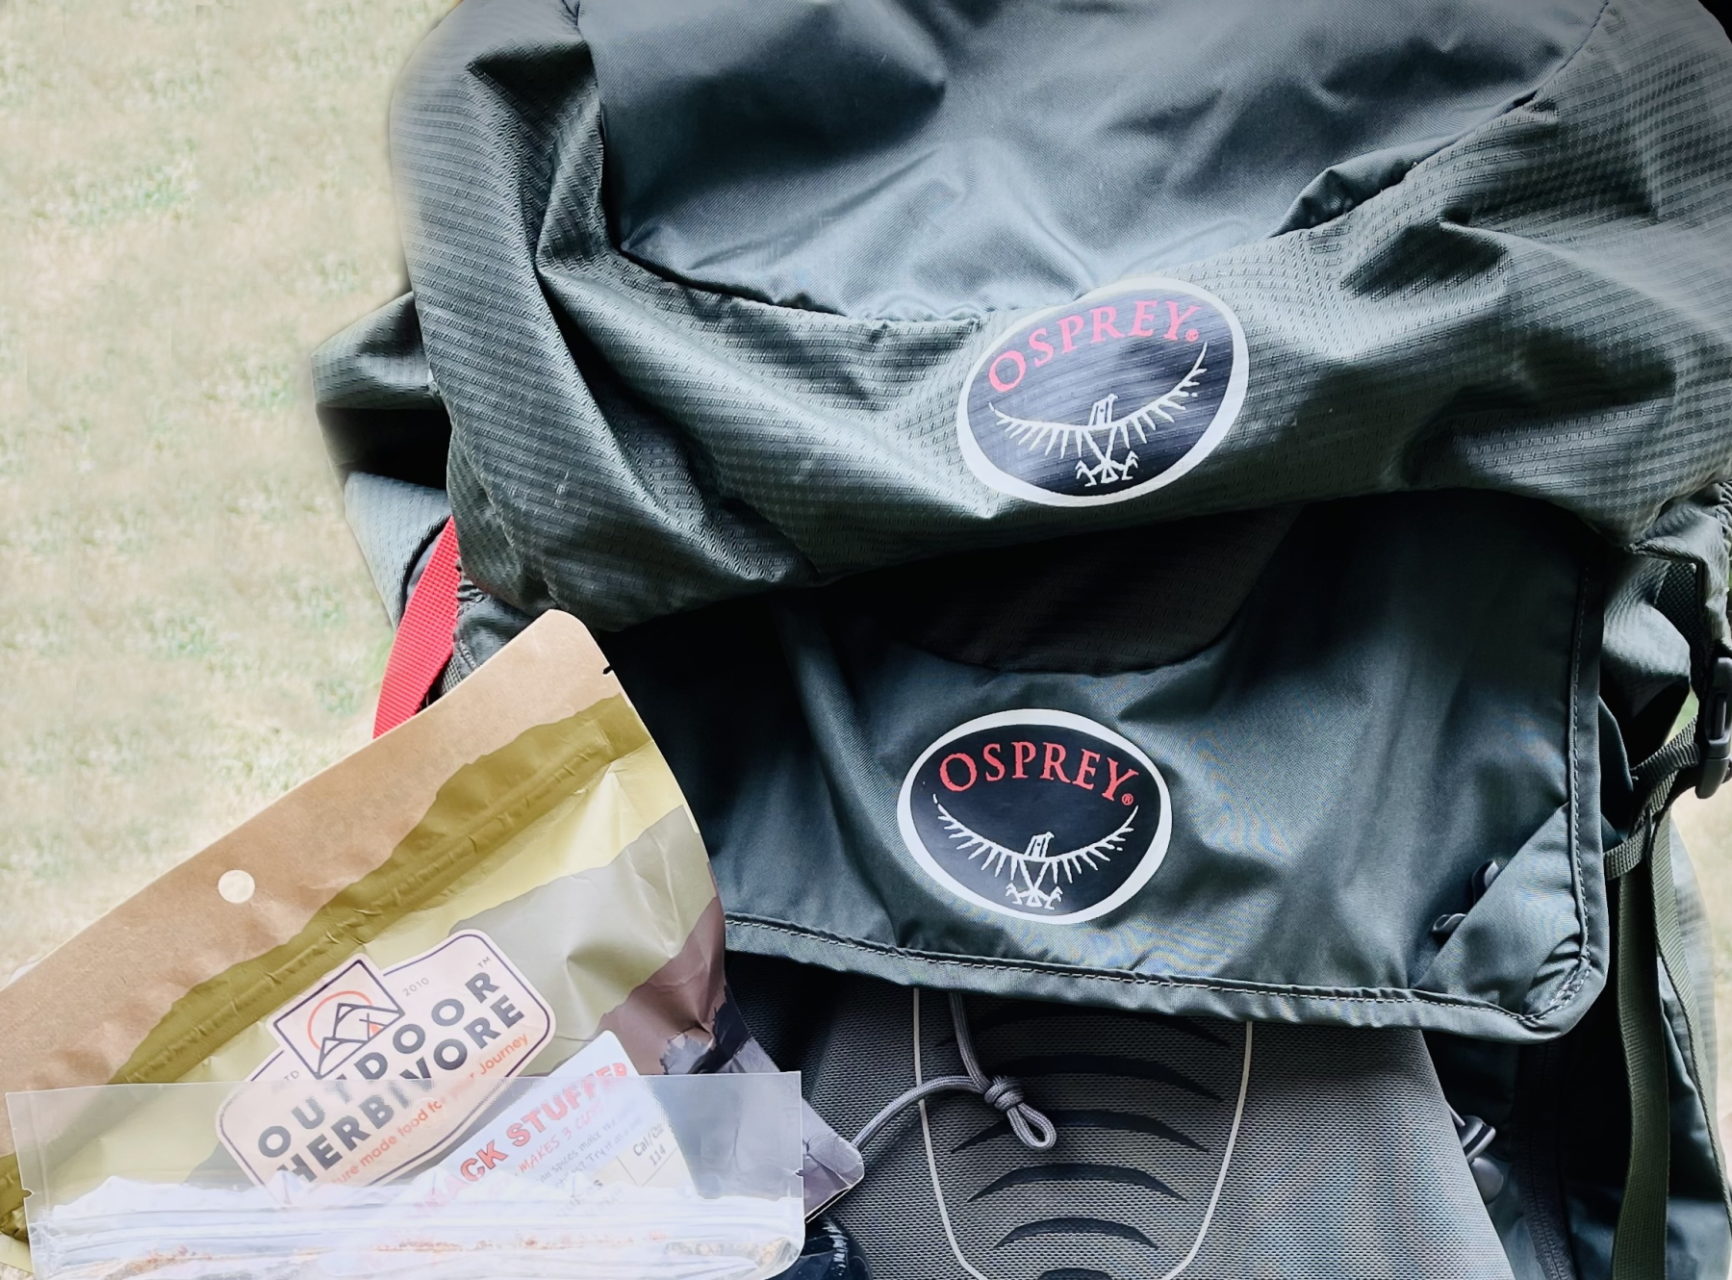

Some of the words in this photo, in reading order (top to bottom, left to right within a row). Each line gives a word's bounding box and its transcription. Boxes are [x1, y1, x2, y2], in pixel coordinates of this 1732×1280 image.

[402, 977, 430, 997] 2010
[258, 972, 500, 1158] OUTDOOR
[479, 1033, 529, 1076] Journey
[276, 995, 525, 1183] HERBIVORE
[360, 1135, 397, 1166] made
